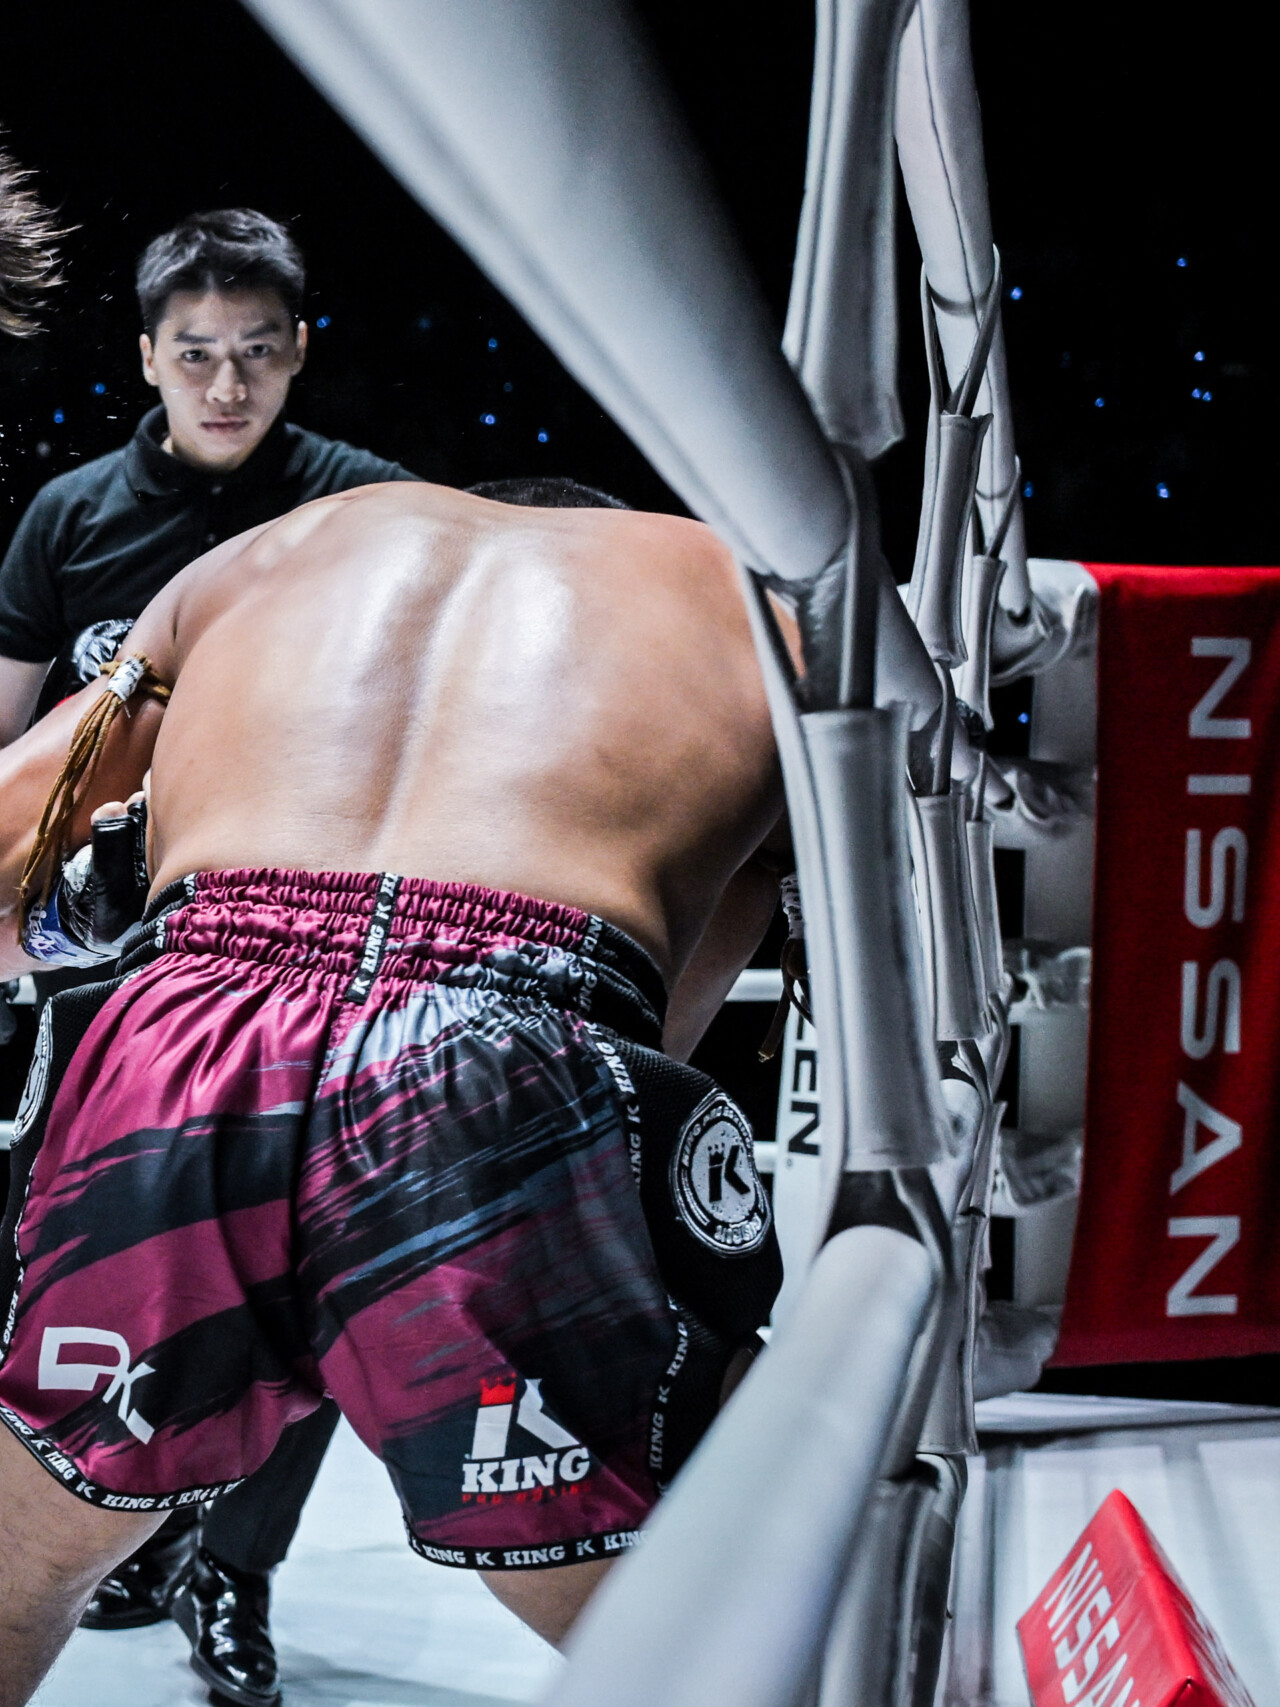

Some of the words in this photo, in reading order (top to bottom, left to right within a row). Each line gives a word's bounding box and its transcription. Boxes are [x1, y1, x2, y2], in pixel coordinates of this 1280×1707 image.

[1166, 636, 1252, 1318] NISSAN
[461, 1447, 590, 1493] KING
[101, 1494, 155, 1509] KING
[504, 1546, 565, 1566] KING
